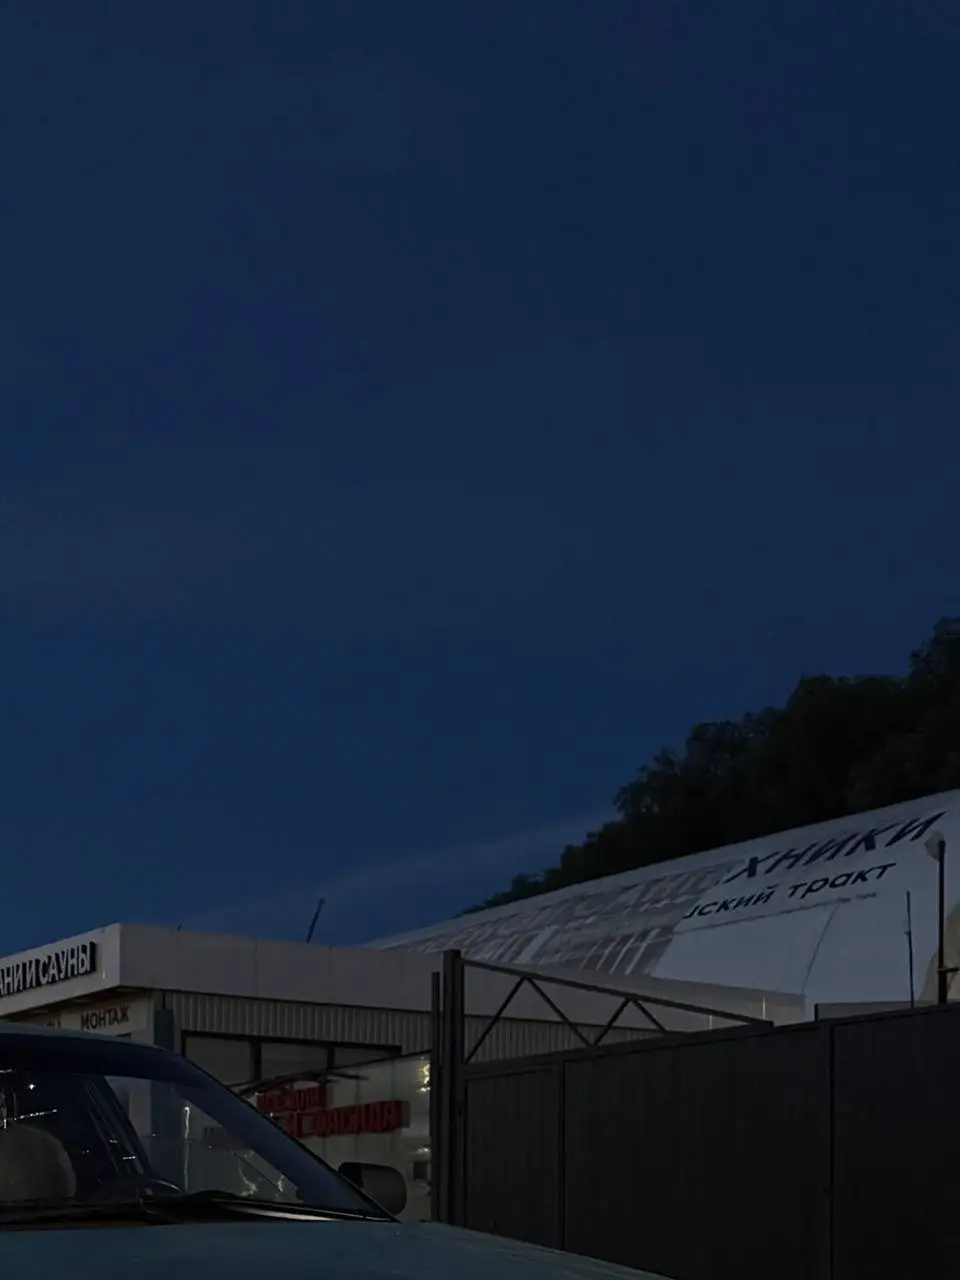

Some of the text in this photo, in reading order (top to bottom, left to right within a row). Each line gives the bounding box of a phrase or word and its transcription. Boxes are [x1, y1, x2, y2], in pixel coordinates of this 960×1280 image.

[25, 959, 37, 989] И
[39, 942, 97, 984] САУНЫ
[81, 1004, 130, 1030] МОНТАЖ
